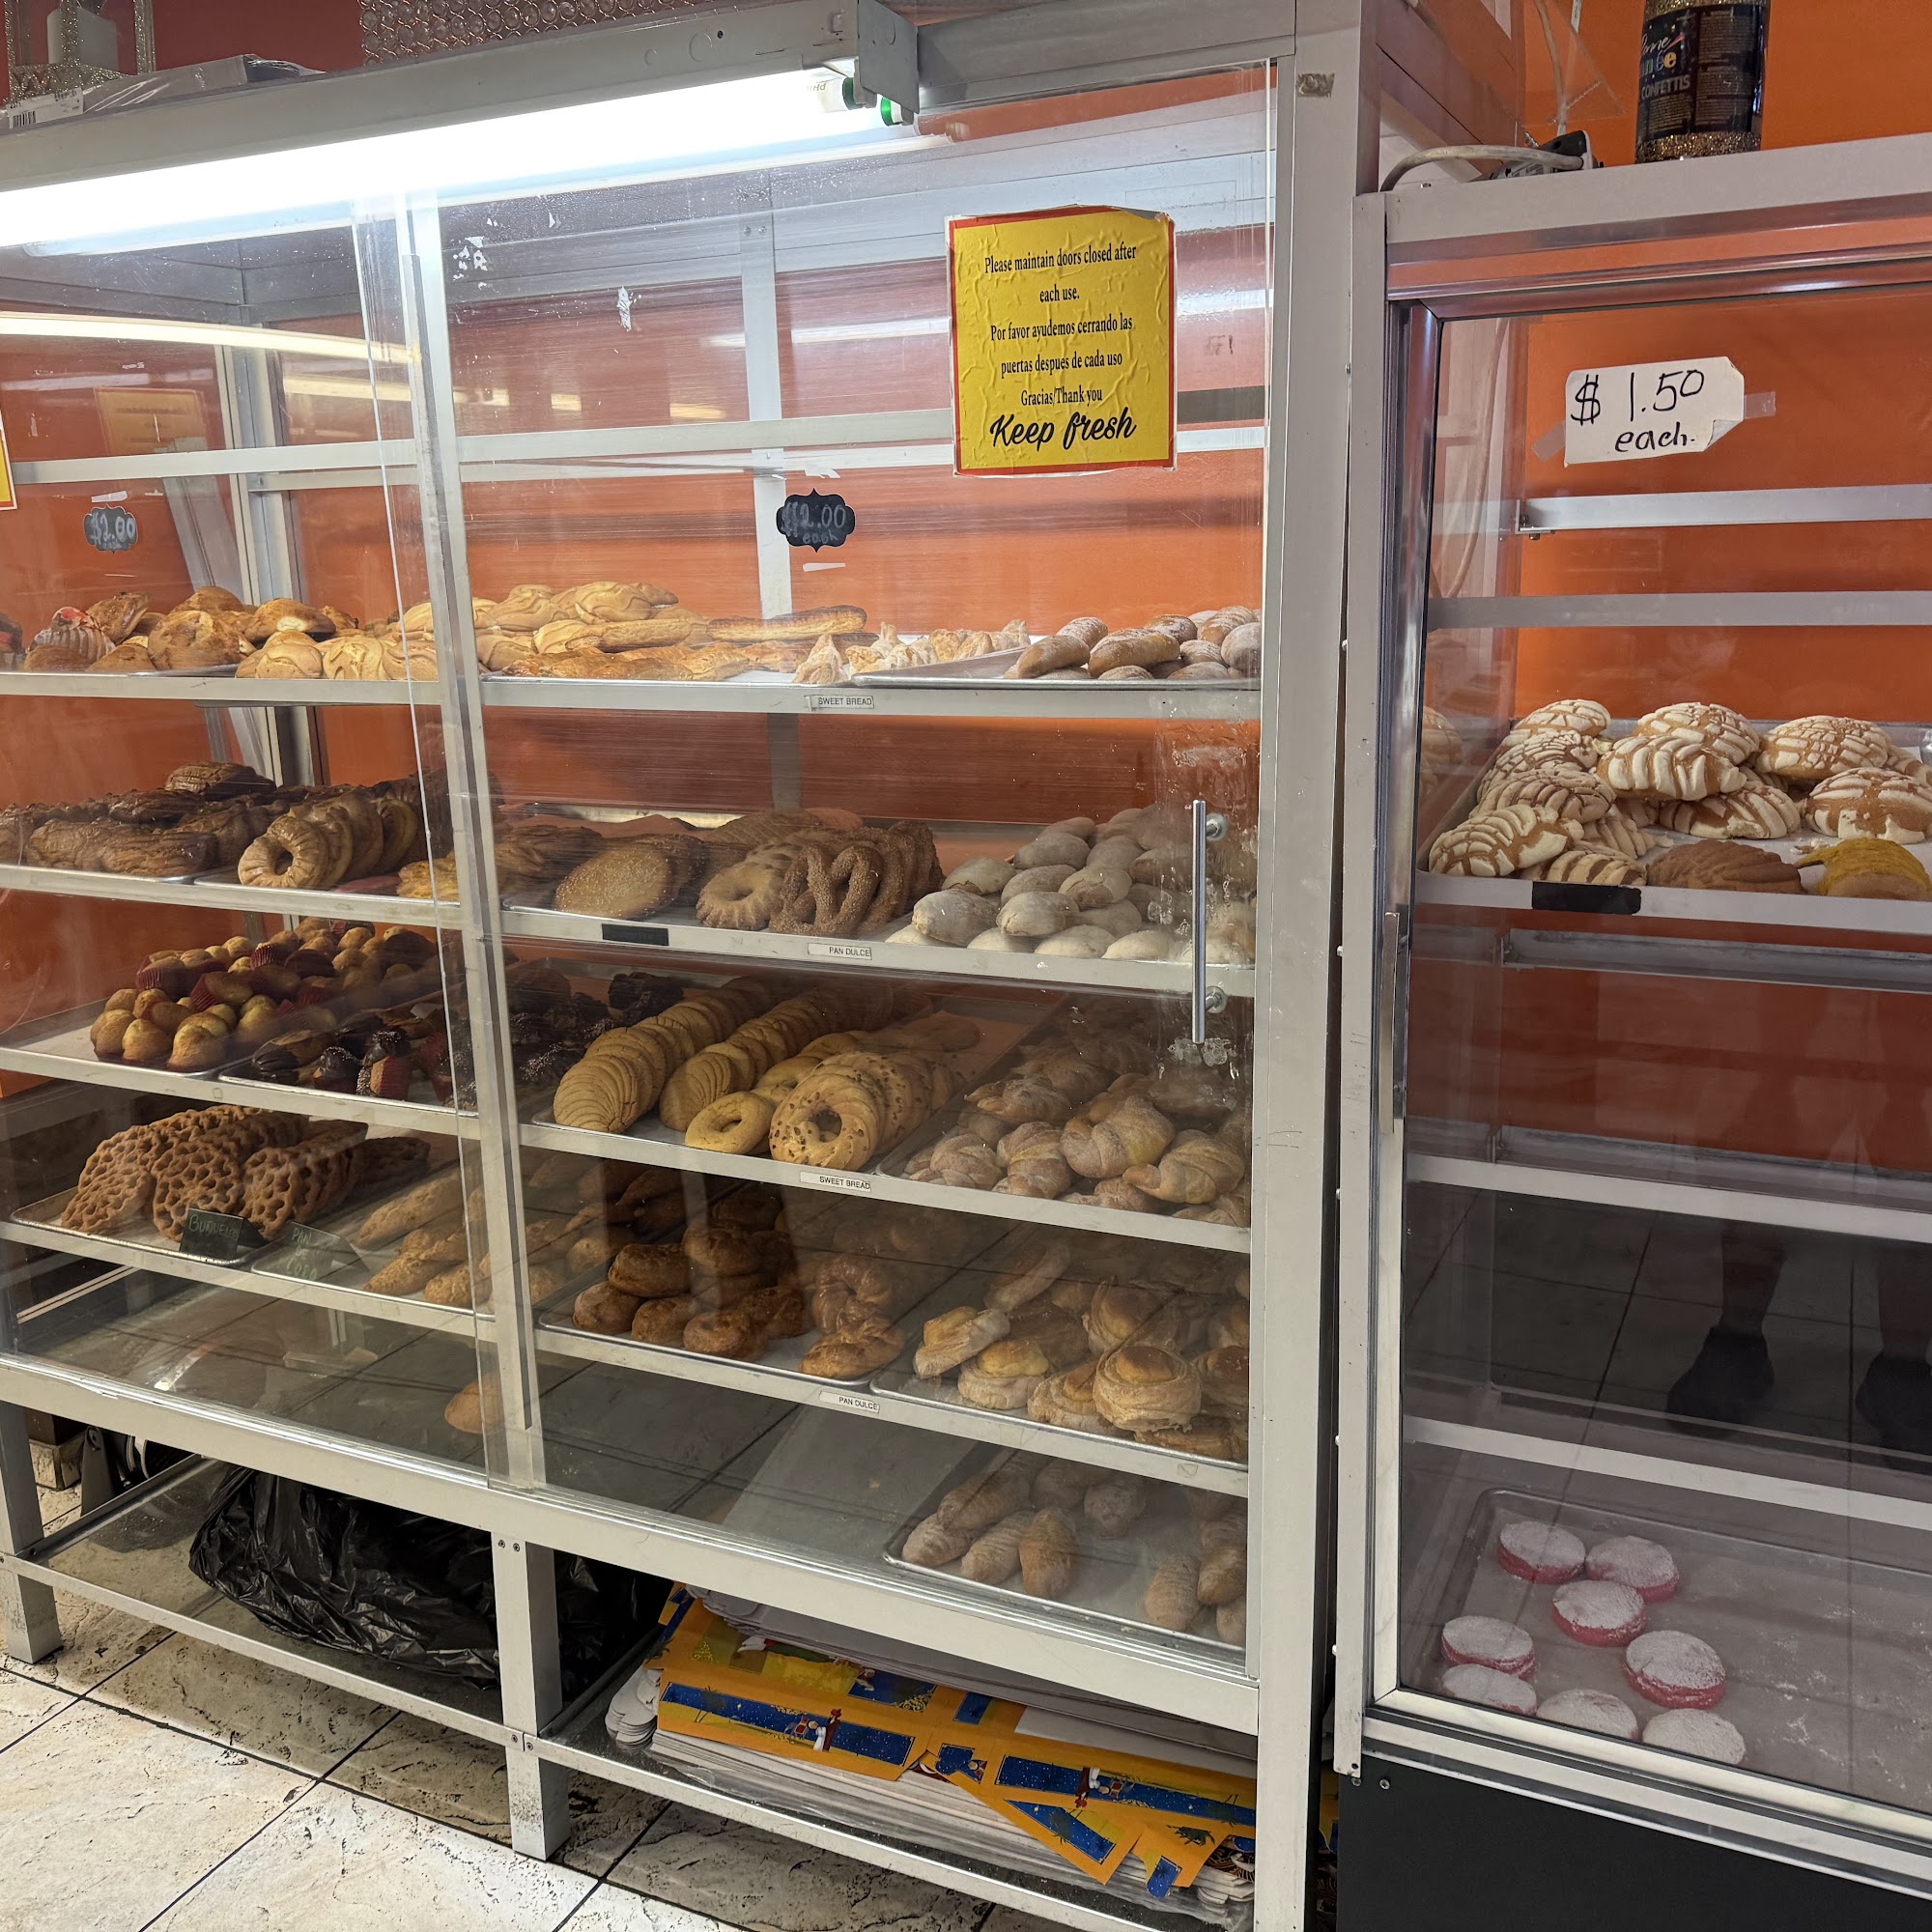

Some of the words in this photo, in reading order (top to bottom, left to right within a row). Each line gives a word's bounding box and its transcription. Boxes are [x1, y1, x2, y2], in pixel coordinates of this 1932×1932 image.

[1641, 74, 1690, 99] CONFETTIS
[984, 255, 1012, 274] Please
[1014, 250, 1054, 270] maintain
[1057, 247, 1082, 267] doors
[1084, 242, 1112, 264] closed
[1114, 241, 1137, 261] after
[1039, 283, 1060, 303] each
[1063, 287, 1080, 301] use.
[990, 325, 1006, 341] Por
[1008, 322, 1031, 340] favor
[1032, 319, 1075, 343] ayudemos
[1077, 313, 1118, 334] cerrando
[1120, 312, 1133, 330] las
[1001, 359, 1033, 379] puertas
[1035, 354, 1069, 376] despues
[1071, 351, 1082, 369] de
[1084, 349, 1105, 368] cada
[1107, 353, 1122, 367] uso
[1087, 389, 1102, 407] you
[1571, 374, 1601, 426] $
[1630, 369, 1705, 422] 1.50
[989, 413, 1055, 452] Keep
[1063, 407, 1137, 450] fresh
[818, 696, 844, 705] SWEET
[846, 697, 872, 706] BREAD
[845, 948, 870, 957] DULCE
[819, 1176, 844, 1186] SWEET
[846, 1179, 870, 1189] BREAD
[292, 1227, 312, 1244] PAN
[838, 1396, 853, 1405] PAN
[855, 1400, 878, 1410] DULCE
